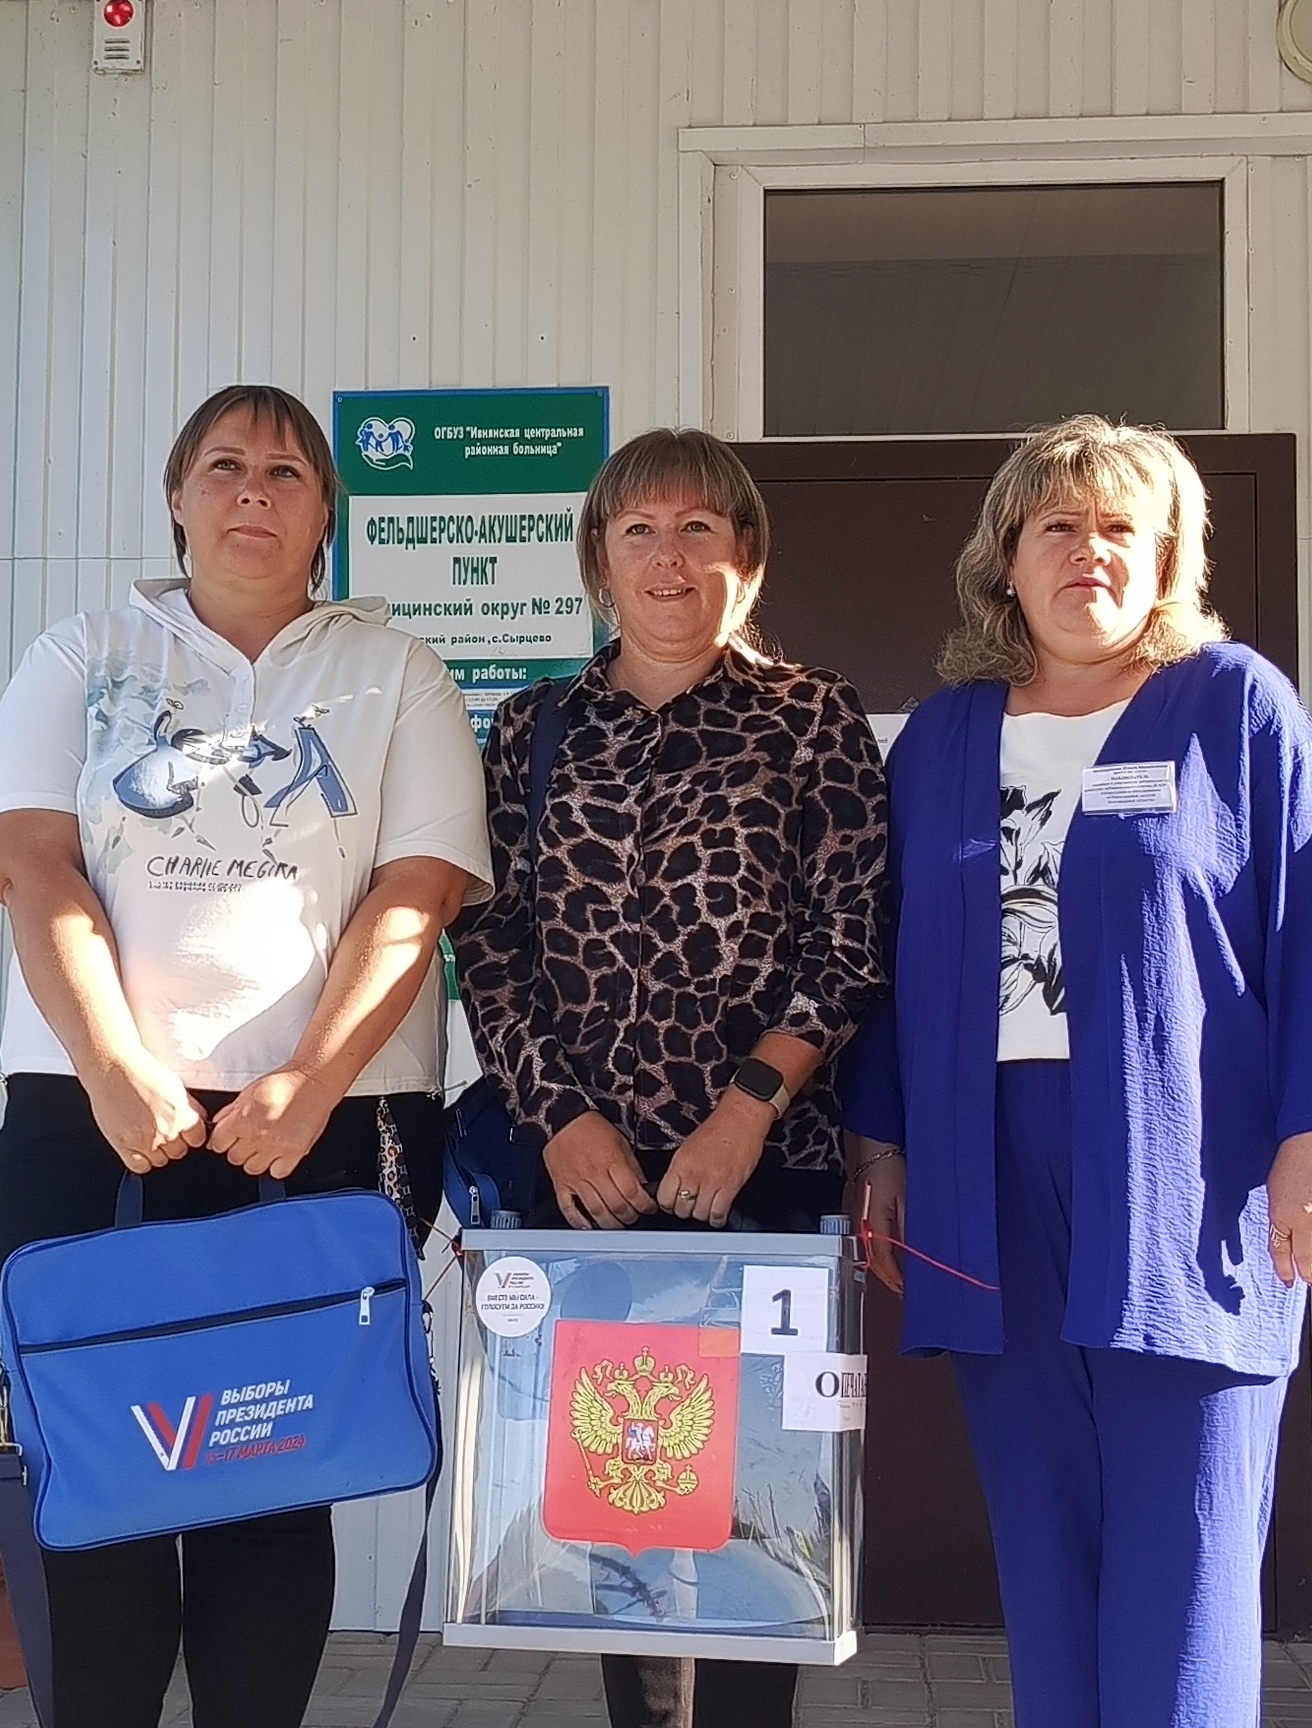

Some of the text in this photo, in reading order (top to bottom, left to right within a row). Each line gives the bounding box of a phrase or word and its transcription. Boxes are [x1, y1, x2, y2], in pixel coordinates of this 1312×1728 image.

[434, 426, 464, 440] ОГБУЗ
[524, 427, 584, 441] центральная
[464, 442, 509, 459] районная
[366, 507, 574, 550] ФЕЛЬДШЕРСКО-АКУШЕРСКИЙ
[452, 557, 498, 586] ПУНКТ
[388, 597, 583, 620] ицинский округ № 297
[472, 664, 528, 684] работы:
[770, 1288, 800, 1336] 1
[220, 1379, 291, 1406] ВЫБОРЫ
[214, 1394, 314, 1427] ПРЕЗИДЕНТА
[209, 1421, 274, 1447] РОССИИ
